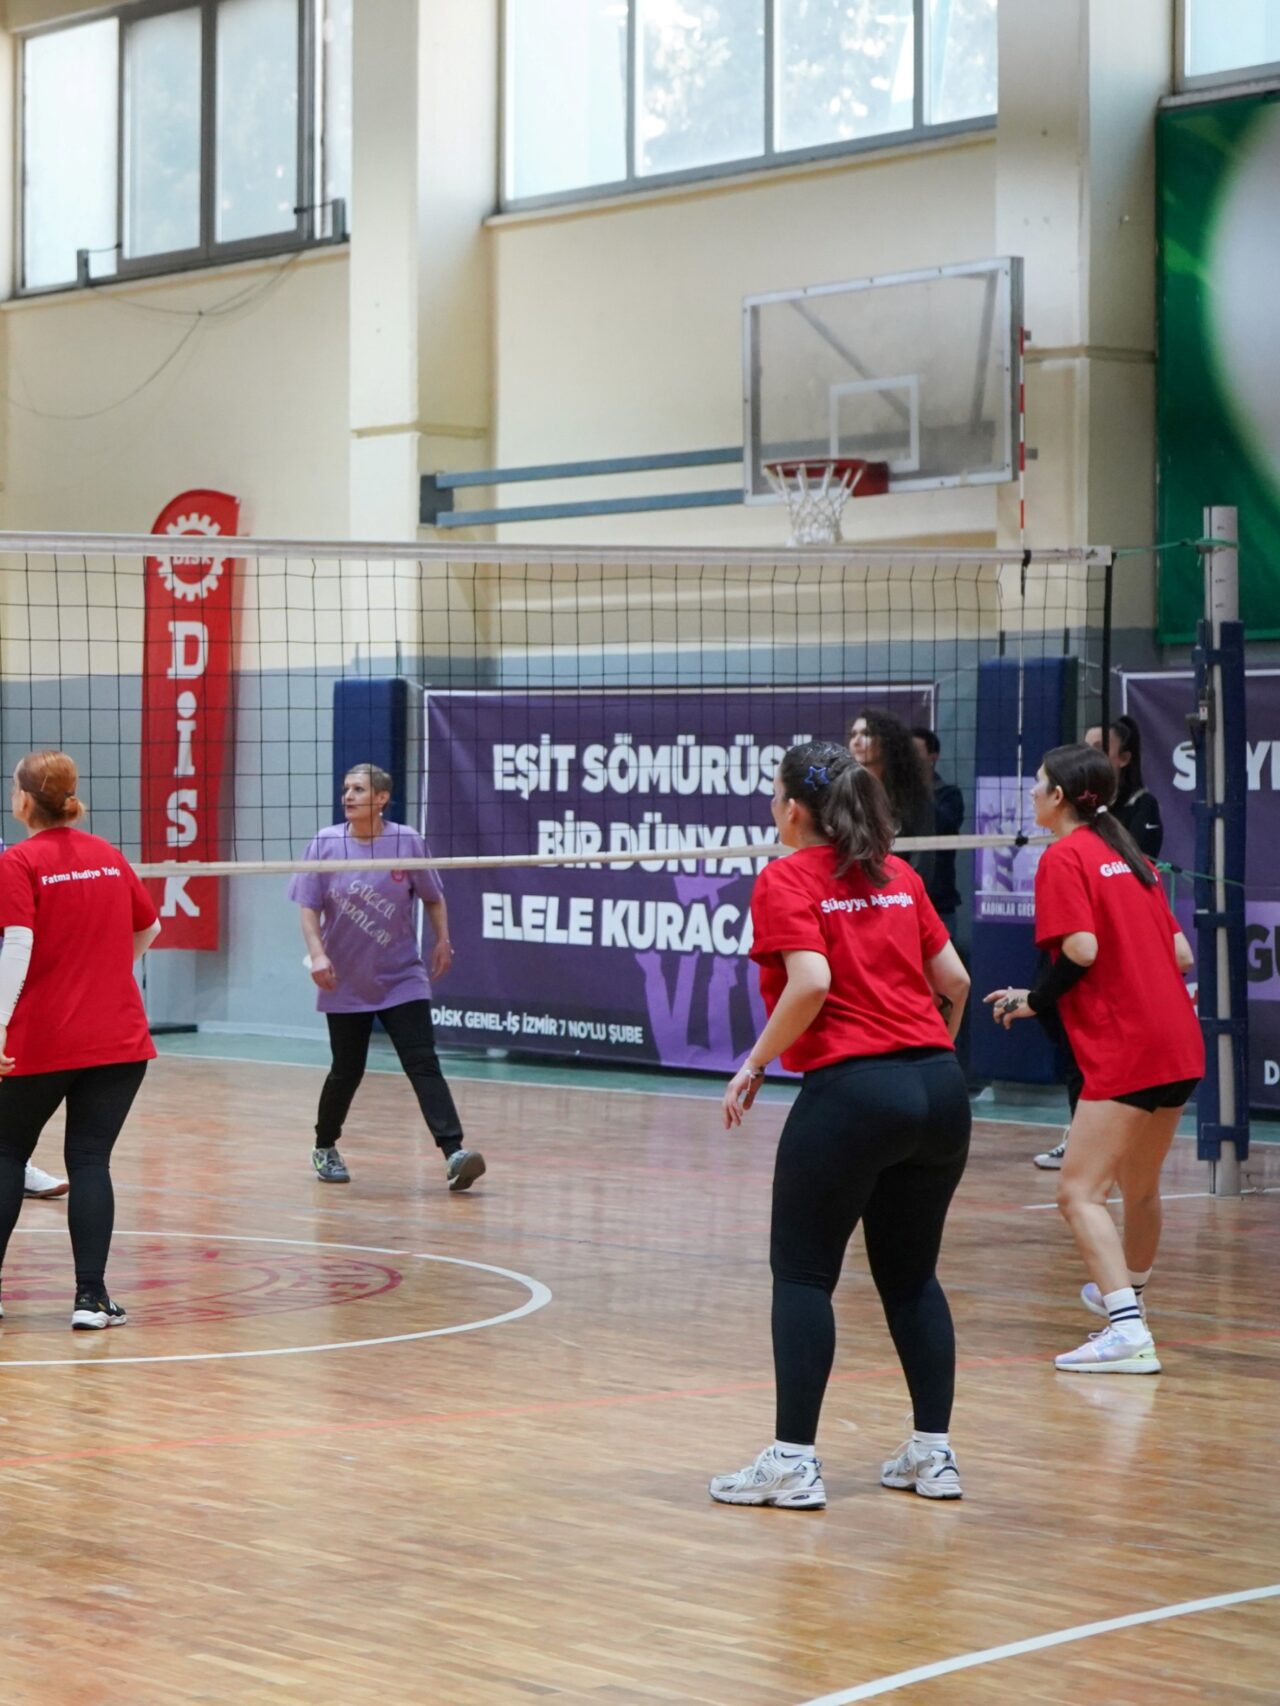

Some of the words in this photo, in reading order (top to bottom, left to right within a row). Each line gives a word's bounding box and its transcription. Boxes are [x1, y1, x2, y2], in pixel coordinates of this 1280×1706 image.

[493, 733, 576, 800] EŞİT
[582, 733, 812, 796] SÖMÜRÜS
[538, 810, 602, 869] BİR
[610, 812, 779, 876] DÜNYAY
[41, 873, 71, 886] Fatma
[482, 892, 593, 946] ELELE
[431, 1005, 462, 1027] DİSK
[464, 1010, 519, 1035] GENEL-İŞ
[522, 1012, 557, 1036] İZMİR
[559, 1020, 567, 1037] 7
[608, 1024, 644, 1044] ŞUBE
